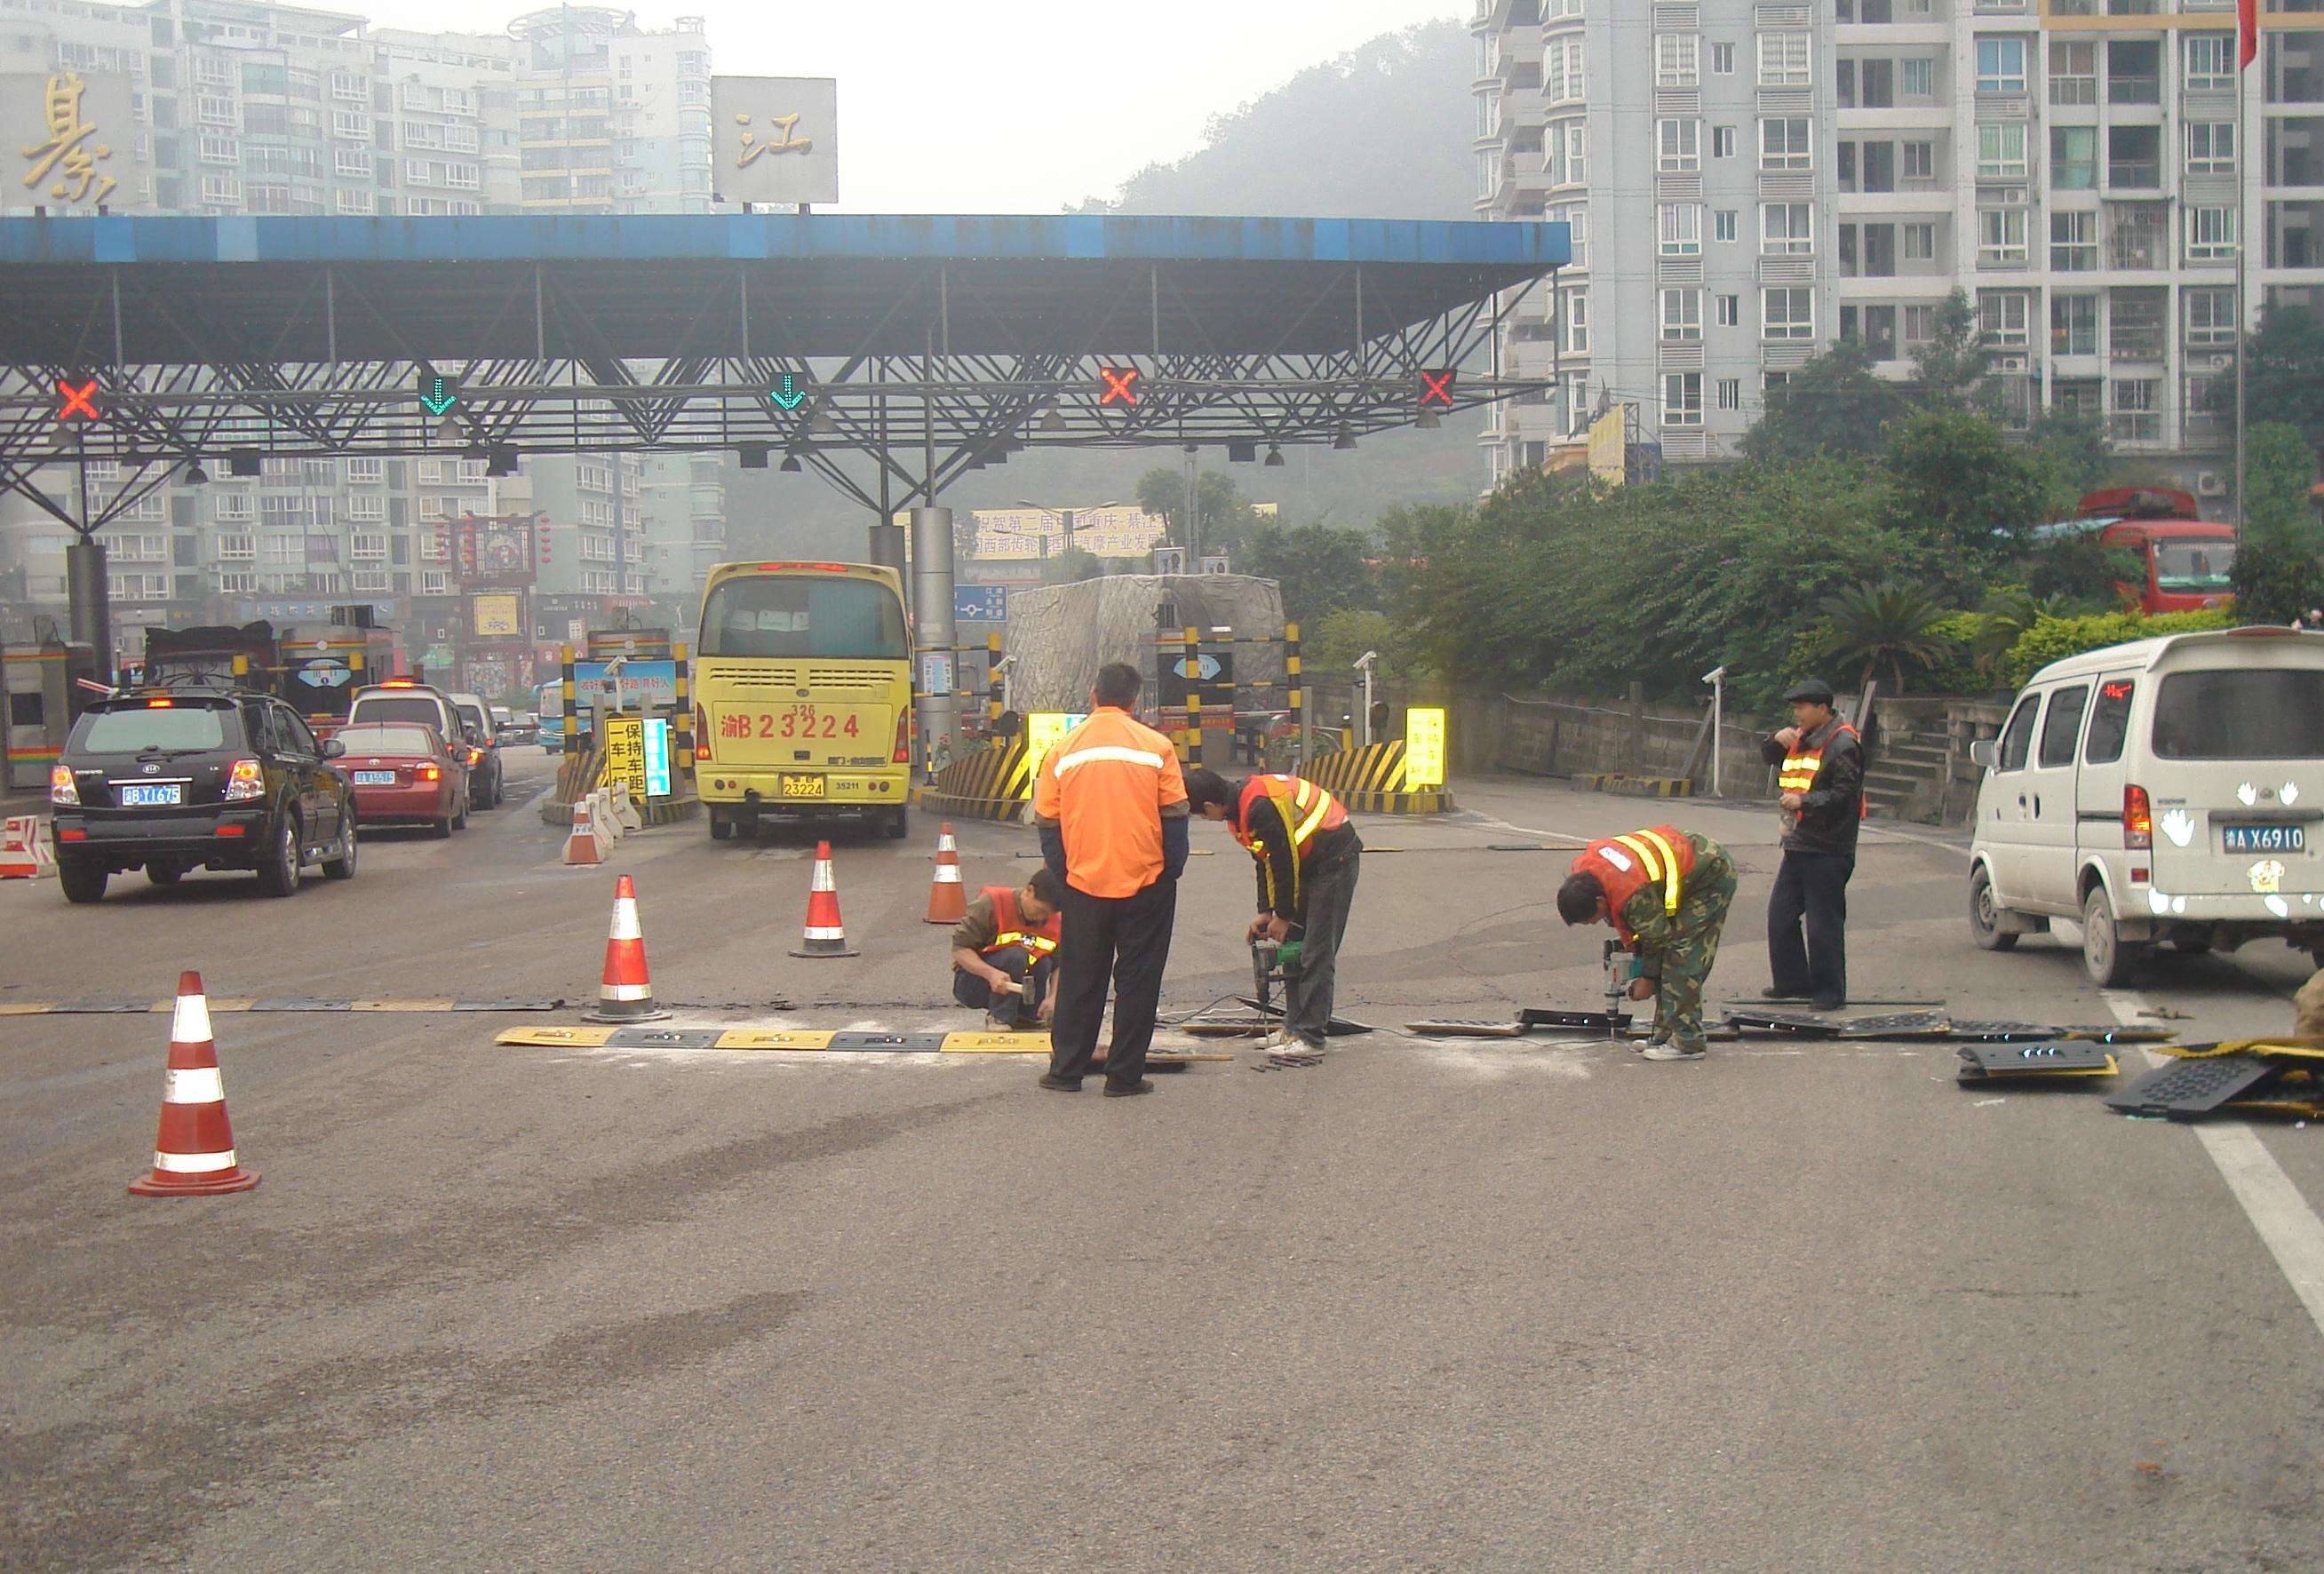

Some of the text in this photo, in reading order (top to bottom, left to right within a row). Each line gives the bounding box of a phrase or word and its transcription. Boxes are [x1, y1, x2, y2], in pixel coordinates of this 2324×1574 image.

[735, 113, 813, 169] 江
[626, 724, 644, 790] 保持车距
[784, 784, 823, 795] 23224
